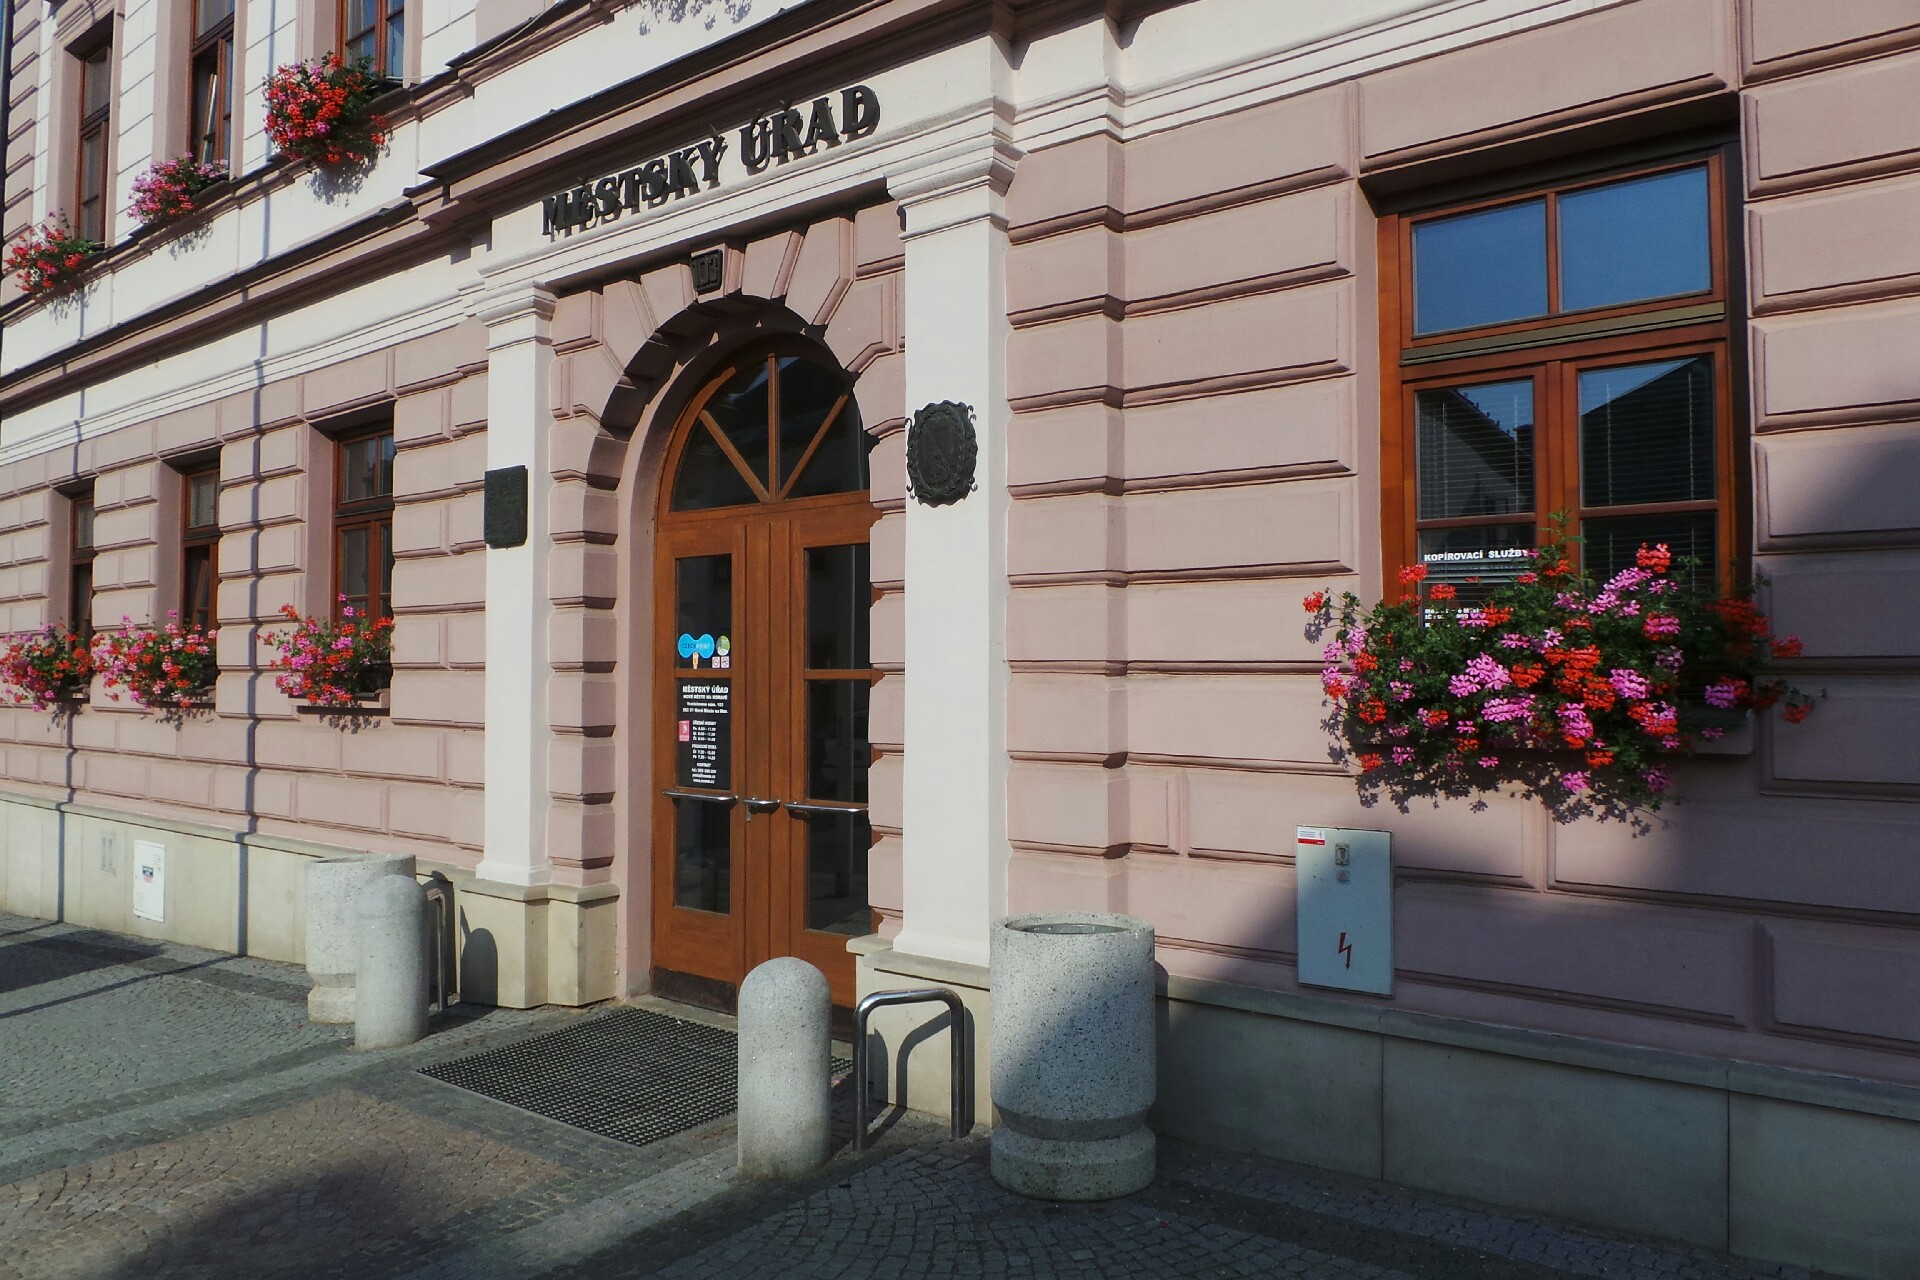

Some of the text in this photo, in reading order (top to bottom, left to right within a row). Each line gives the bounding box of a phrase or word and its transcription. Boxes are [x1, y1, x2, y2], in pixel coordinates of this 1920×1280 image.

[542, 84, 881, 239] MĚSTSKÝ ÚŘAD
[1424, 550, 1483, 562] KOPÍROVACÍ
[682, 684, 729, 694] MĚSTSKÝ ÚŘAD
